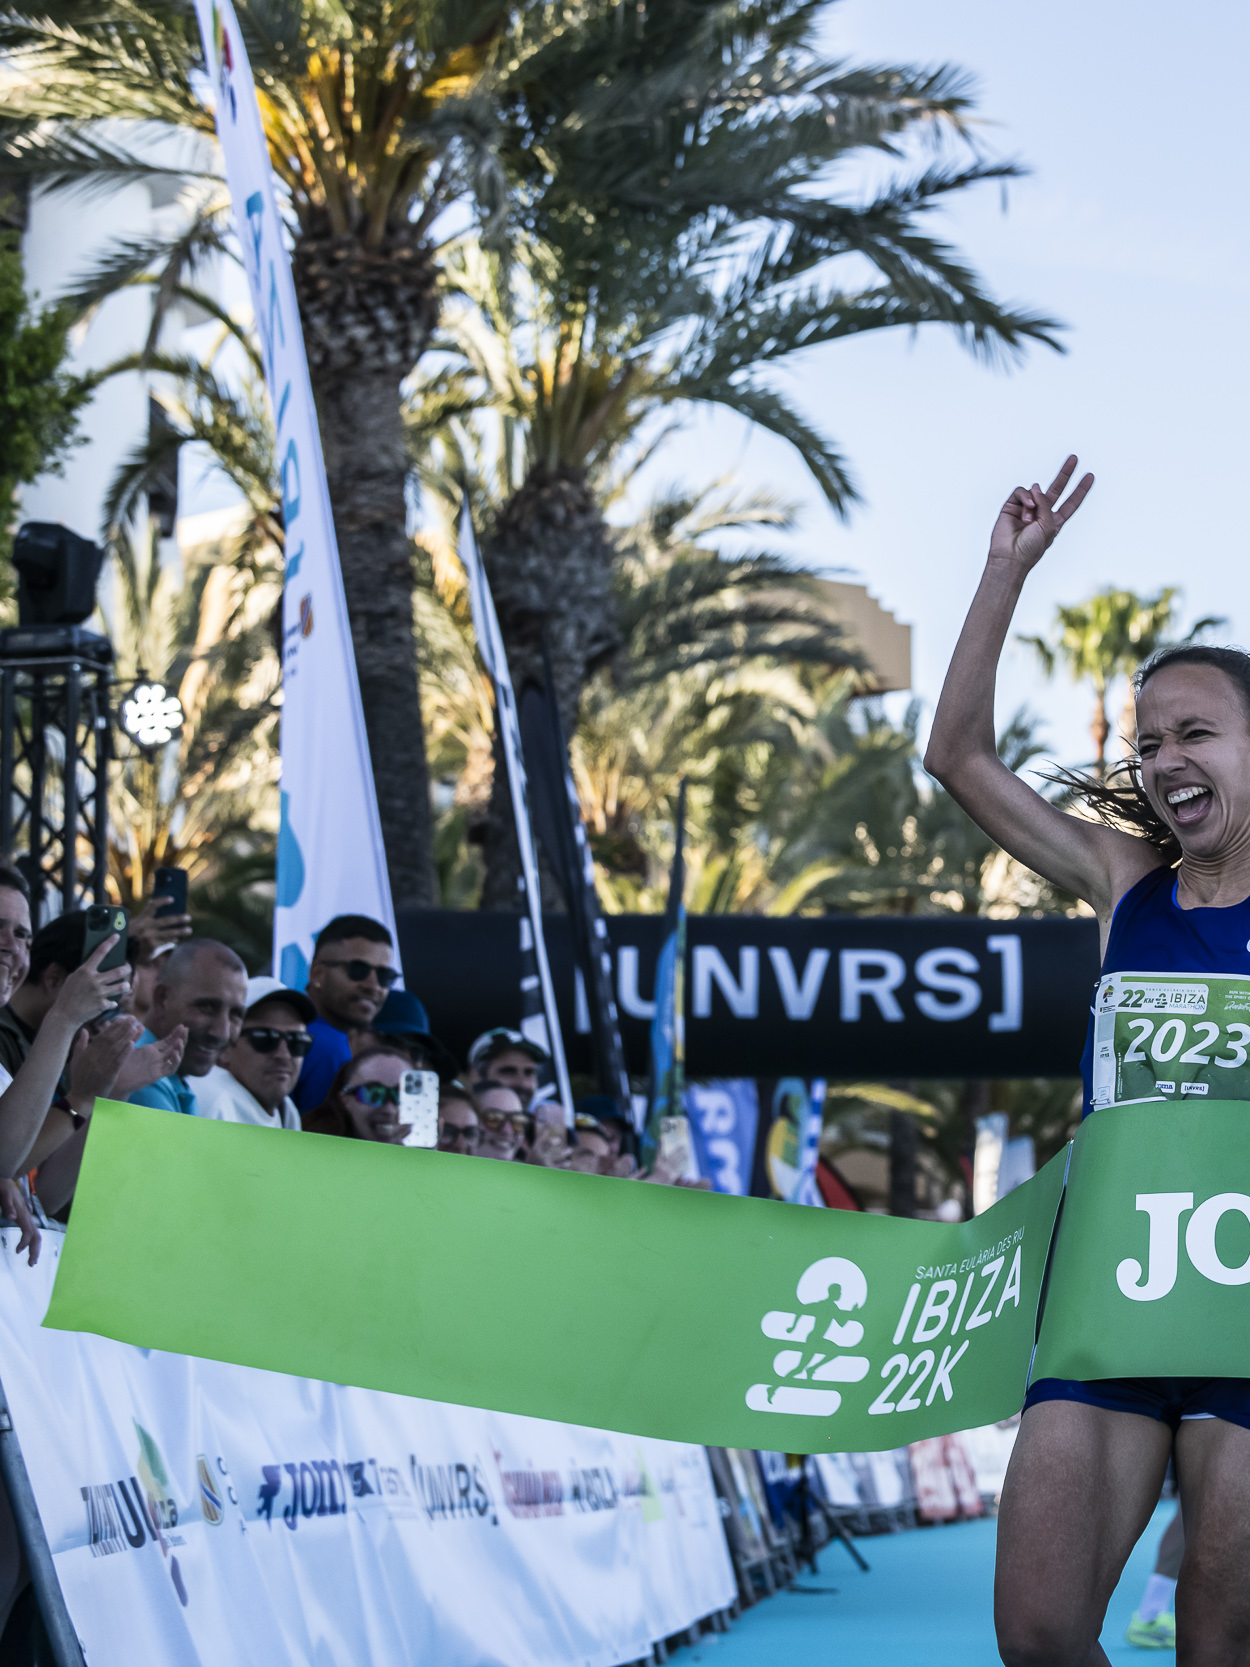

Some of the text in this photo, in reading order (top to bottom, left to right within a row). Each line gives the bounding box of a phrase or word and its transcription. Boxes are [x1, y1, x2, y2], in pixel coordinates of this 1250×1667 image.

[1118, 989, 1145, 1007] 22
[1170, 993, 1206, 1004] IBIZA
[915, 1226, 1025, 1280] SANTA EULÀRIA DES RIU
[893, 1245, 1022, 1345] IBIZA
[868, 1339, 970, 1415] 22K
